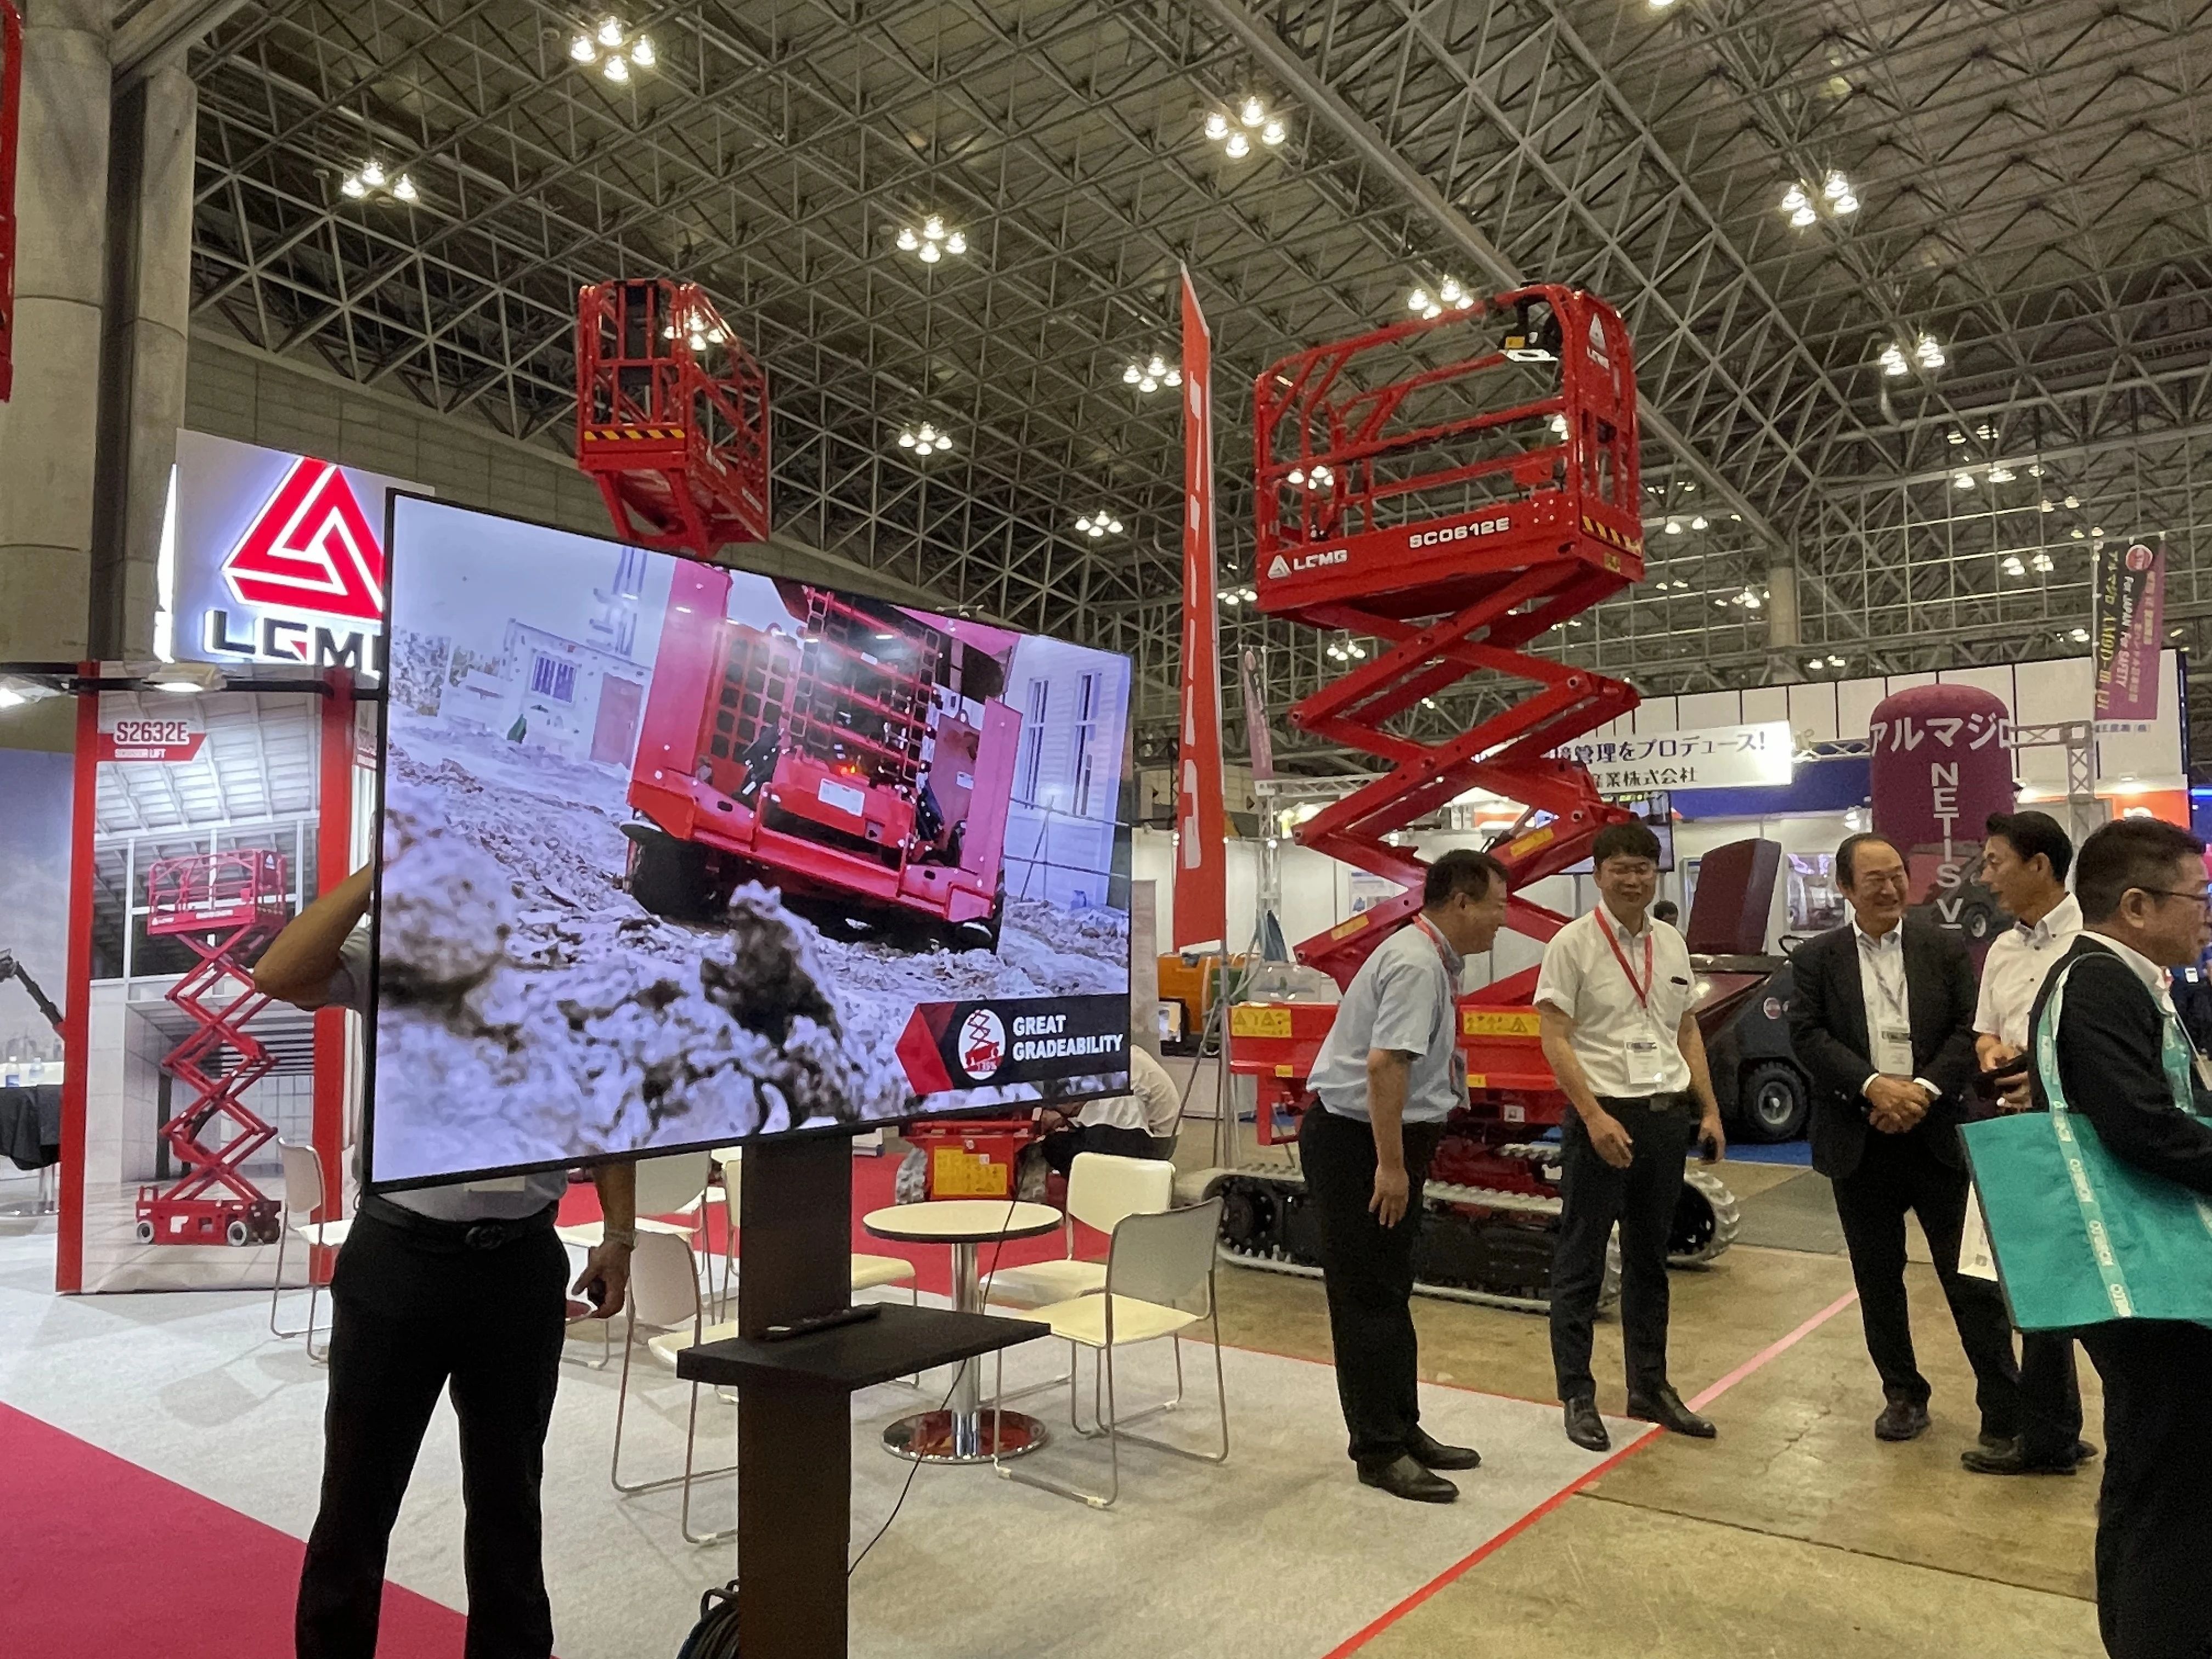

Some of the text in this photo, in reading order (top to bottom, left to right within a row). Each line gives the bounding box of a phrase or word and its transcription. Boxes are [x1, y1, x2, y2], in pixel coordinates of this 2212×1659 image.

[207, 610, 383, 675] LGM
[116, 721, 188, 742] S2632E
[1870, 712, 2012, 757] アルマジロ
[1931, 761, 1962, 888] NETIS
[1013, 1015, 1066, 1036] GREAT
[1013, 1034, 1123, 1062] GRADEABILITY
